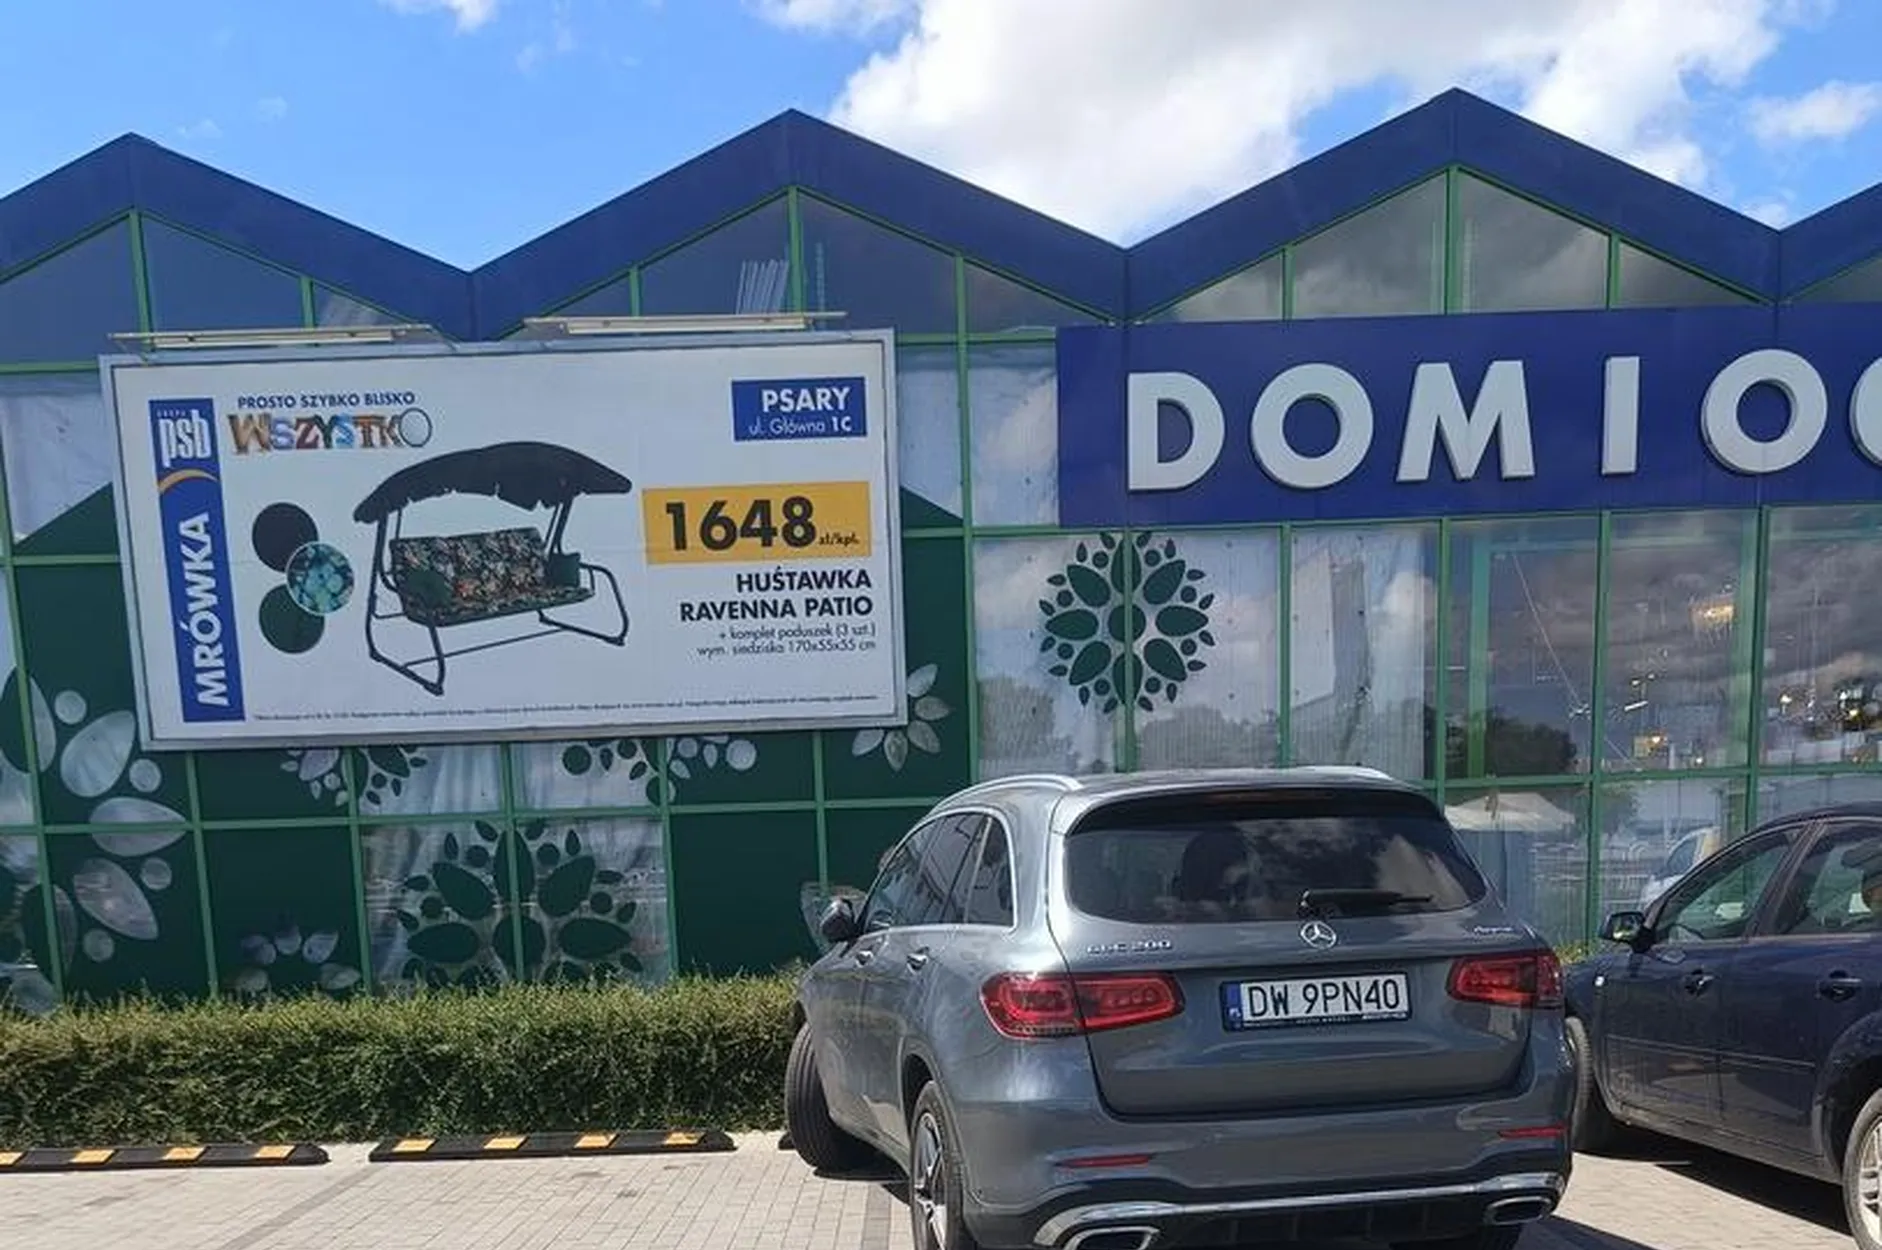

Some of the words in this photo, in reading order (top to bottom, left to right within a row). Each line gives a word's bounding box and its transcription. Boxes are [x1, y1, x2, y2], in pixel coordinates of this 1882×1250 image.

[238, 395, 297, 409] PROSTO
[300, 392, 361, 408] SZYBKO
[363, 390, 416, 406] BLISKO
[761, 386, 851, 413] PSARY
[227, 406, 433, 456] WSZYSTKO
[748, 416, 766, 436] ul.
[769, 414, 826, 436] Główna
[832, 415, 853, 433] 1C
[1127, 360, 1536, 493] DOM
[1602, 356, 1640, 475] I
[1700, 347, 1882, 476] O
[159, 408, 212, 468] psb
[666, 495, 817, 551] 1648
[736, 566, 873, 594] HUŚTAWKA
[178, 512, 230, 707] MRÓWKA
[680, 598, 798, 623] RAVENNA
[805, 595, 874, 618] PATIO
[730, 625, 776, 641] komplet
[777, 622, 833, 640] poduszek
[697, 645, 727, 660] wym.
[732, 640, 786, 656] siedziska
[788, 637, 857, 653] 170x55x55
[858, 640, 876, 651] cm
[1247, 983, 1290, 1017] DW
[1302, 977, 1401, 1015] 9PN40
